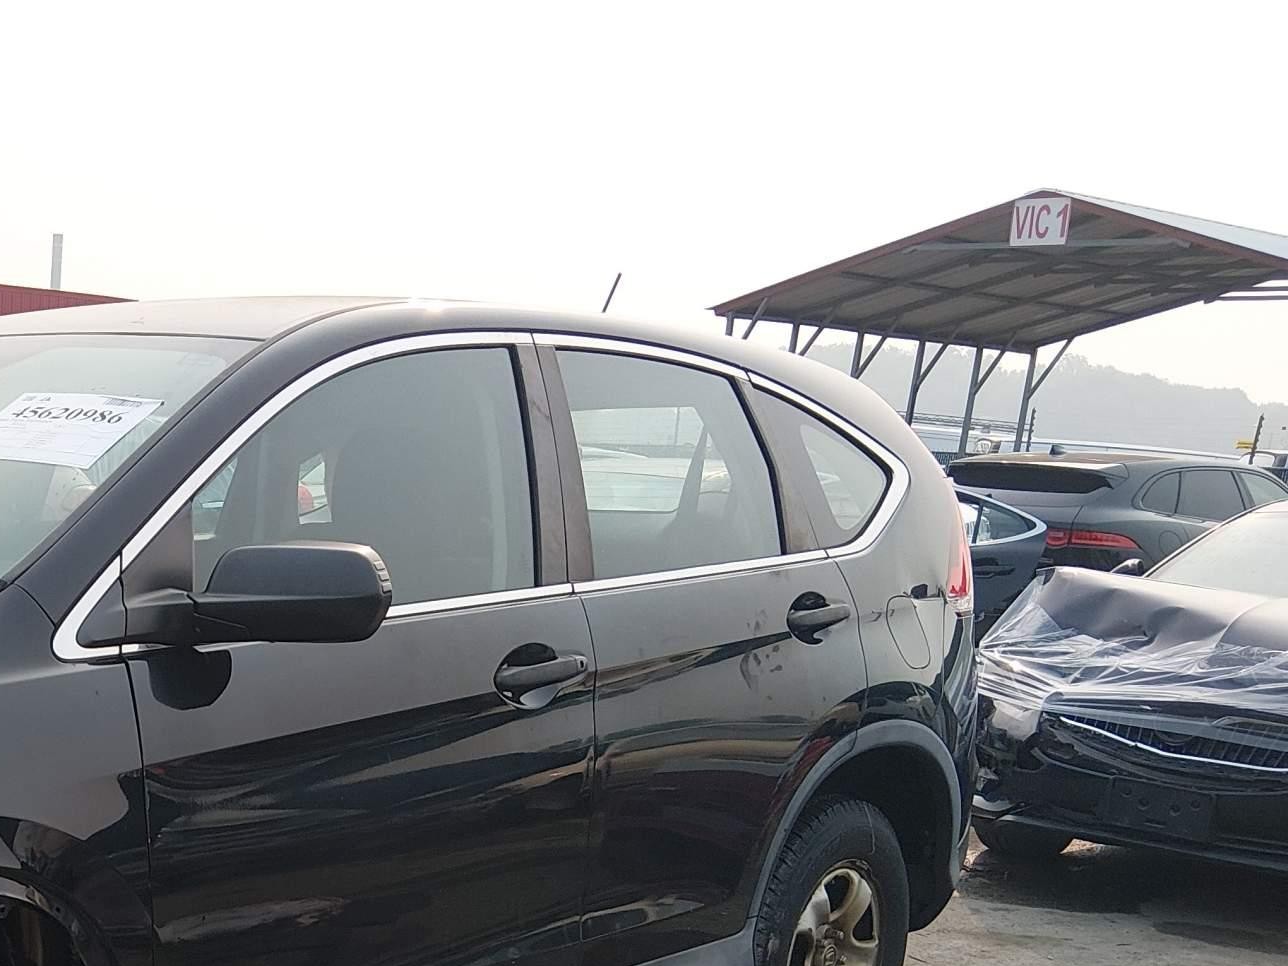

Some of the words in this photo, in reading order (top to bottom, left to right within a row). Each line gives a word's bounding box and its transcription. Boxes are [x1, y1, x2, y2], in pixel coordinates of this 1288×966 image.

[1014, 204, 1049, 240] VIC
[1056, 203, 1070, 239] 1
[11, 406, 129, 424] 45620986
